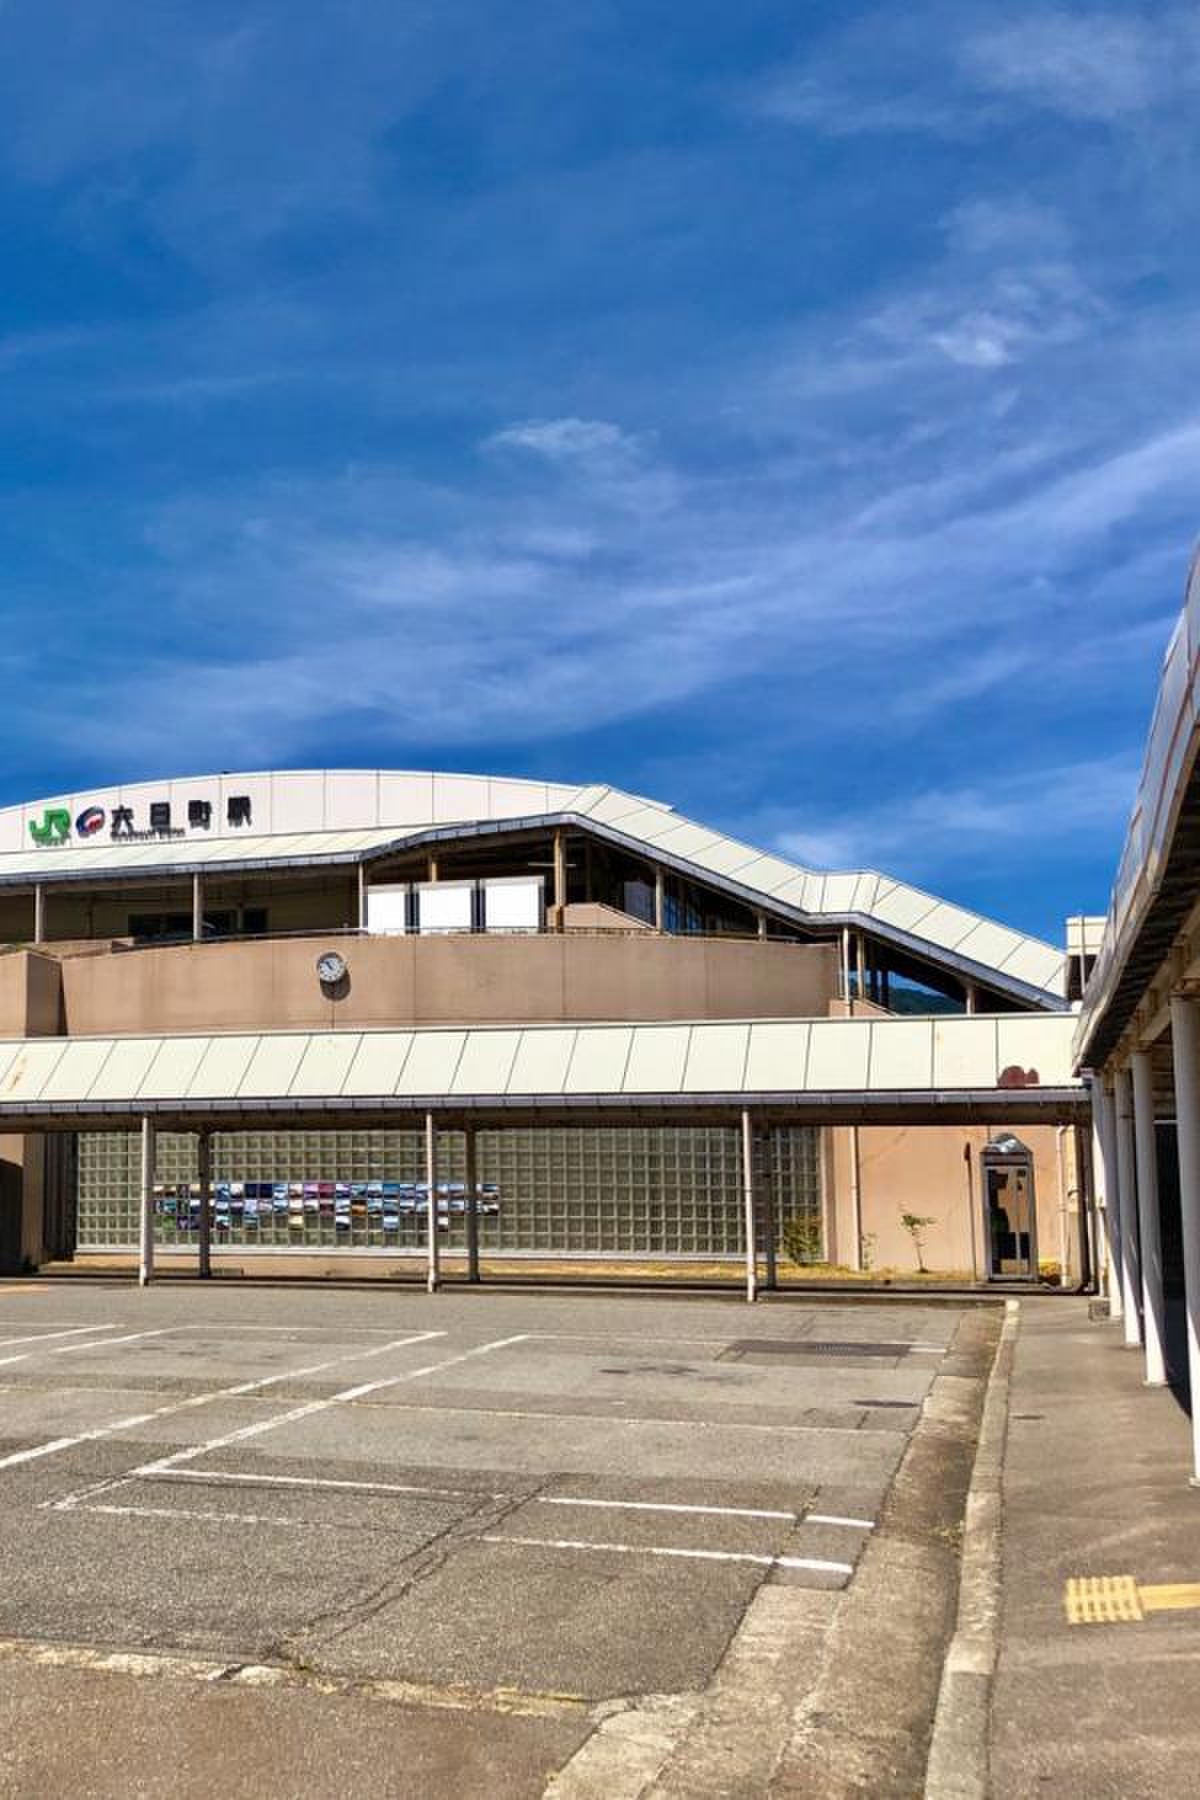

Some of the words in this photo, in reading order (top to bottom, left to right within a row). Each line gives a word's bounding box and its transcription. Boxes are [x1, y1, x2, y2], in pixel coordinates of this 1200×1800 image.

[29, 808, 72, 839] JR
[110, 796, 252, 831] 六日町駅
